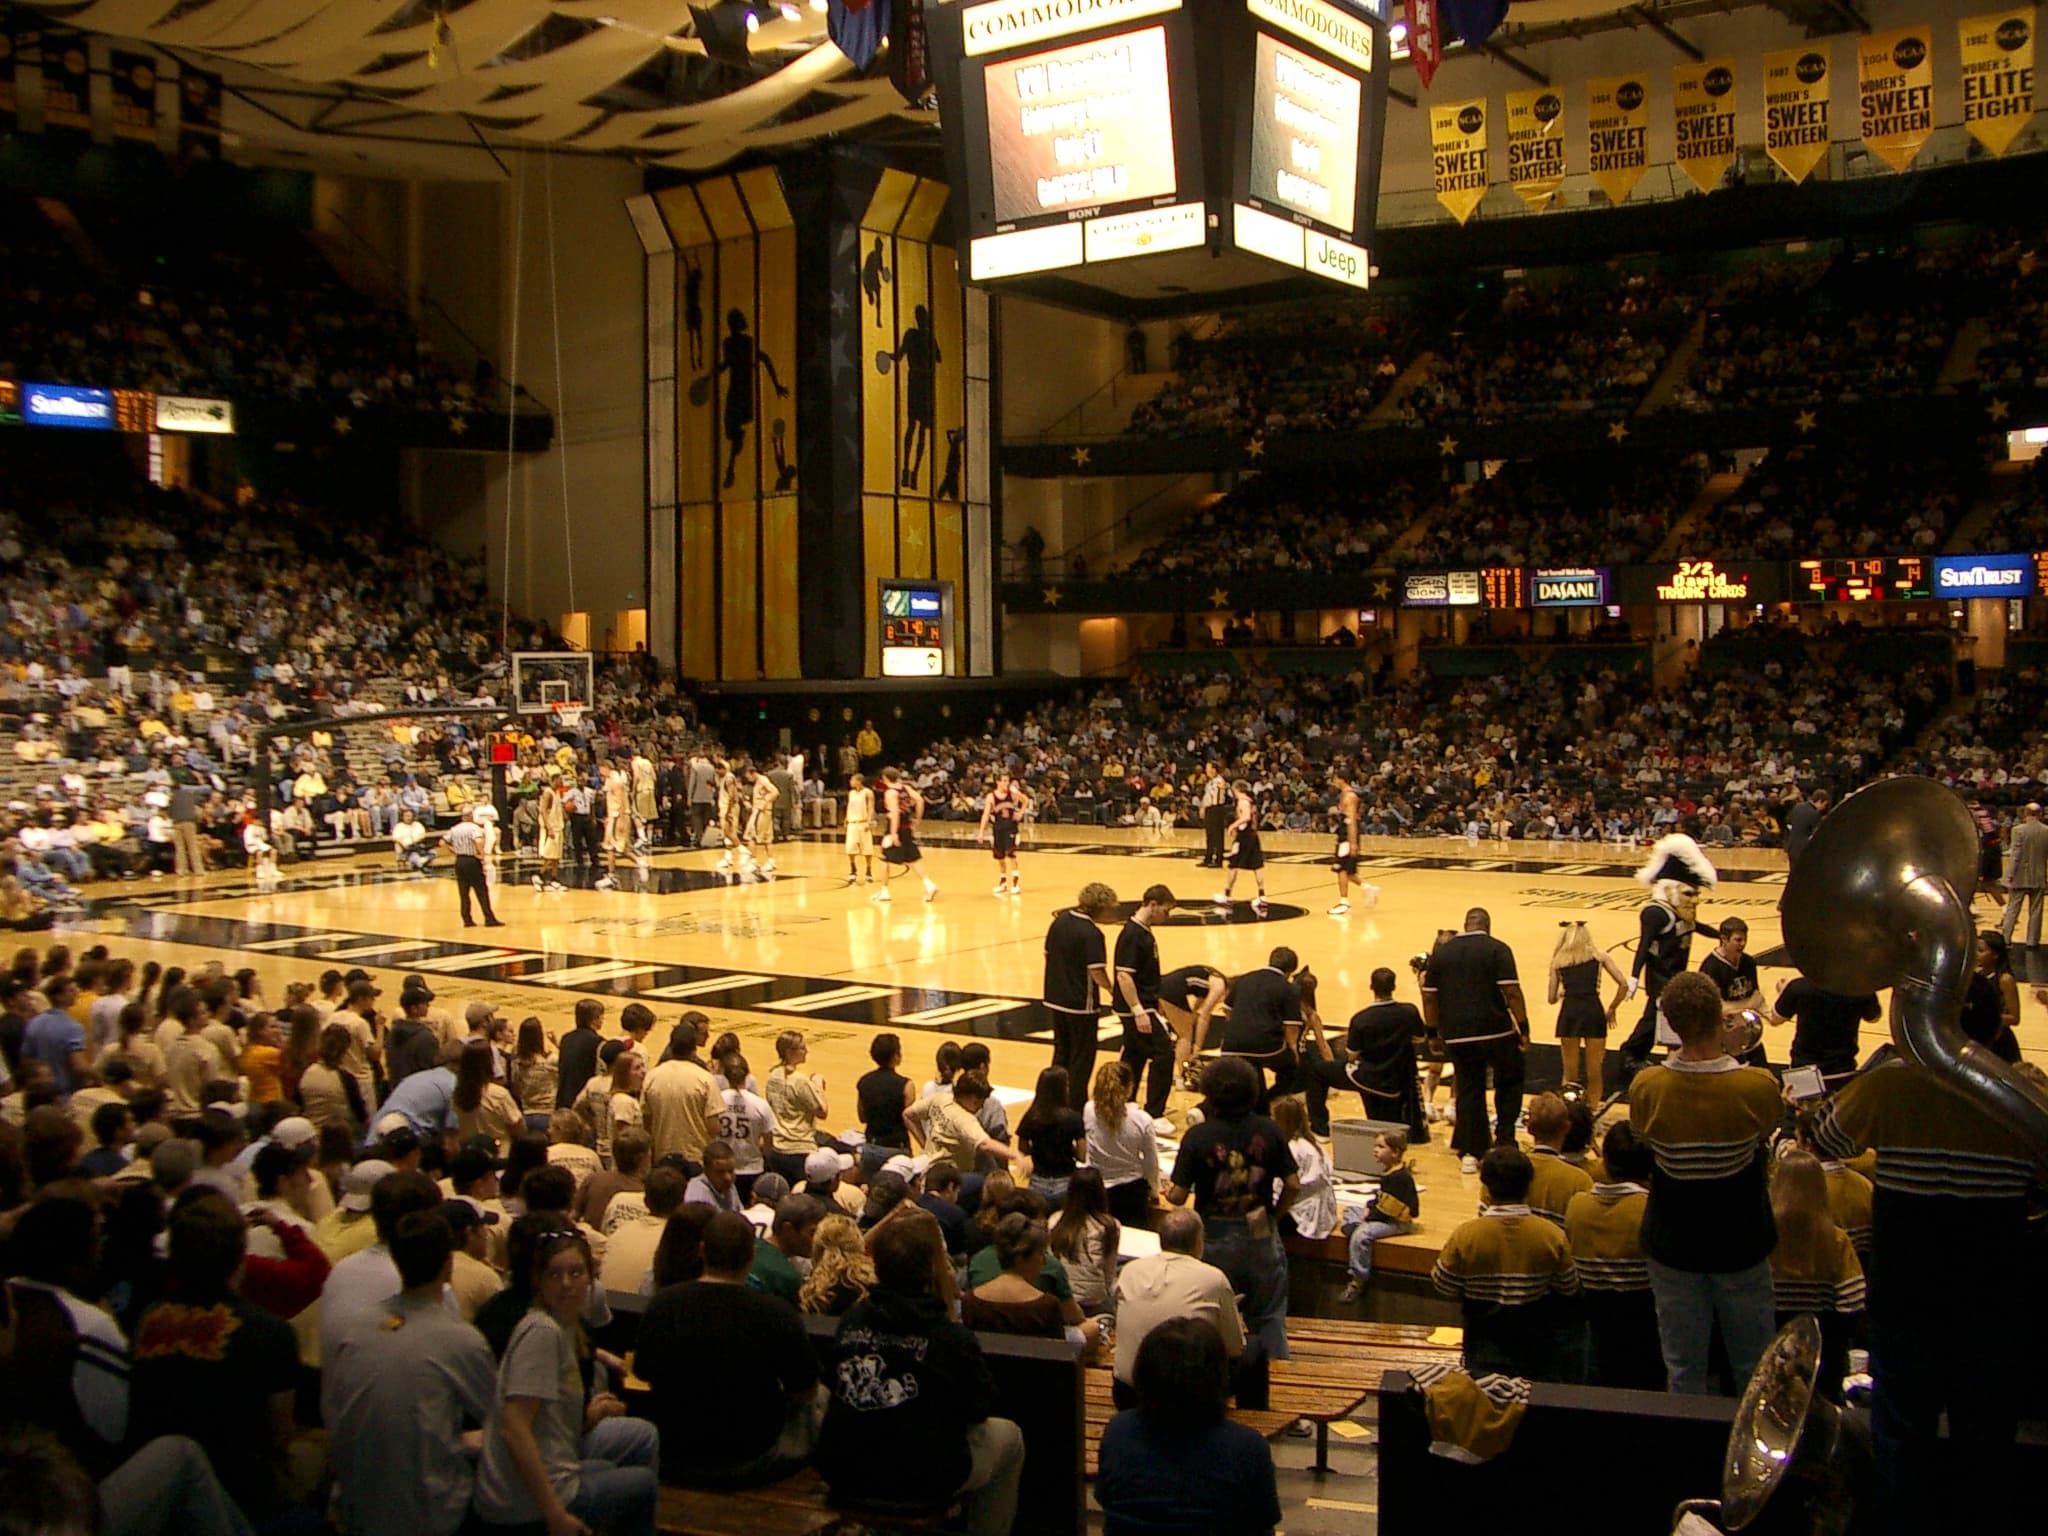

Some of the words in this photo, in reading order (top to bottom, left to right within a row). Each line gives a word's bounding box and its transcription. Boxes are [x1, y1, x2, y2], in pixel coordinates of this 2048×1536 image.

[1964, 68, 2033, 101] ELITE
[1861, 85, 1932, 118] SWEET
[1965, 96, 2032, 121] EIGHT
[1677, 112, 1735, 141] SWEET
[1767, 100, 1830, 130] SWEET
[1861, 110, 1930, 138] SIXTEEN
[1590, 127, 1647, 153] SWEET
[1677, 137, 1734, 160] SIXTEEN
[1767, 125, 1828, 149] SIXTEEN
[1435, 149, 1487, 176] SWEET
[1509, 138, 1563, 164] SWEET
[1590, 150, 1645, 172] SIXTEEN
[1435, 171, 1486, 193] SIXTEEN
[1509, 160, 1562, 182] SIXTEEN
[1068, 207, 1101, 220] SONY
[1318, 239, 1357, 279] Jeep
[1678, 561, 1714, 576] 3/2
[1539, 582, 1595, 600] DASANI
[1657, 586, 1705, 599] TRADING
[1709, 584, 1747, 598] CARDS
[719, 1116, 750, 1140] 35
